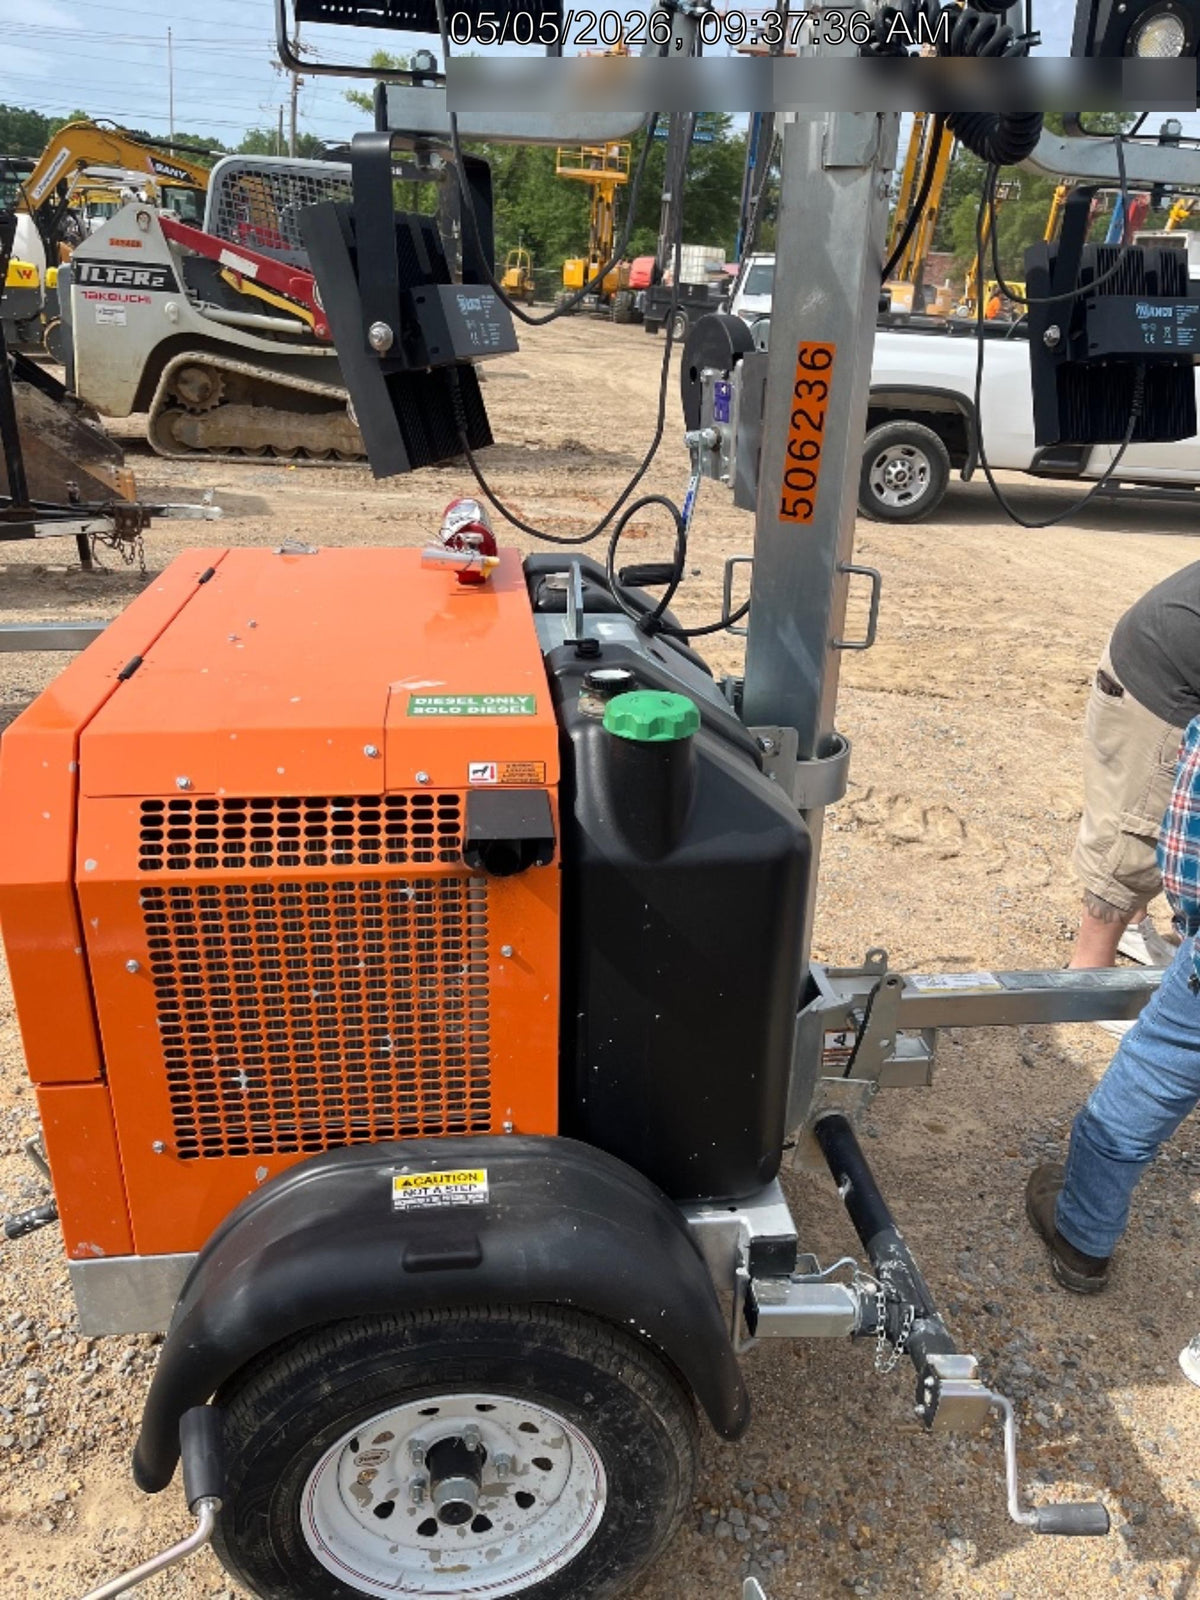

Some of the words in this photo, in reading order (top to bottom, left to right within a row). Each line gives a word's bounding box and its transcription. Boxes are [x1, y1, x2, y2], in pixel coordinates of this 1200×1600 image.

[780, 348, 833, 519] 506236
[414, 696, 479, 705] DIESEL
[482, 695, 530, 705] ONLY
[412, 706, 462, 714] SOLO
[467, 705, 533, 714] DIESEL
[413, 1172, 478, 1187] CAUTION
[402, 1187, 429, 1197] NOT
[433, 1186, 442, 1194] A
